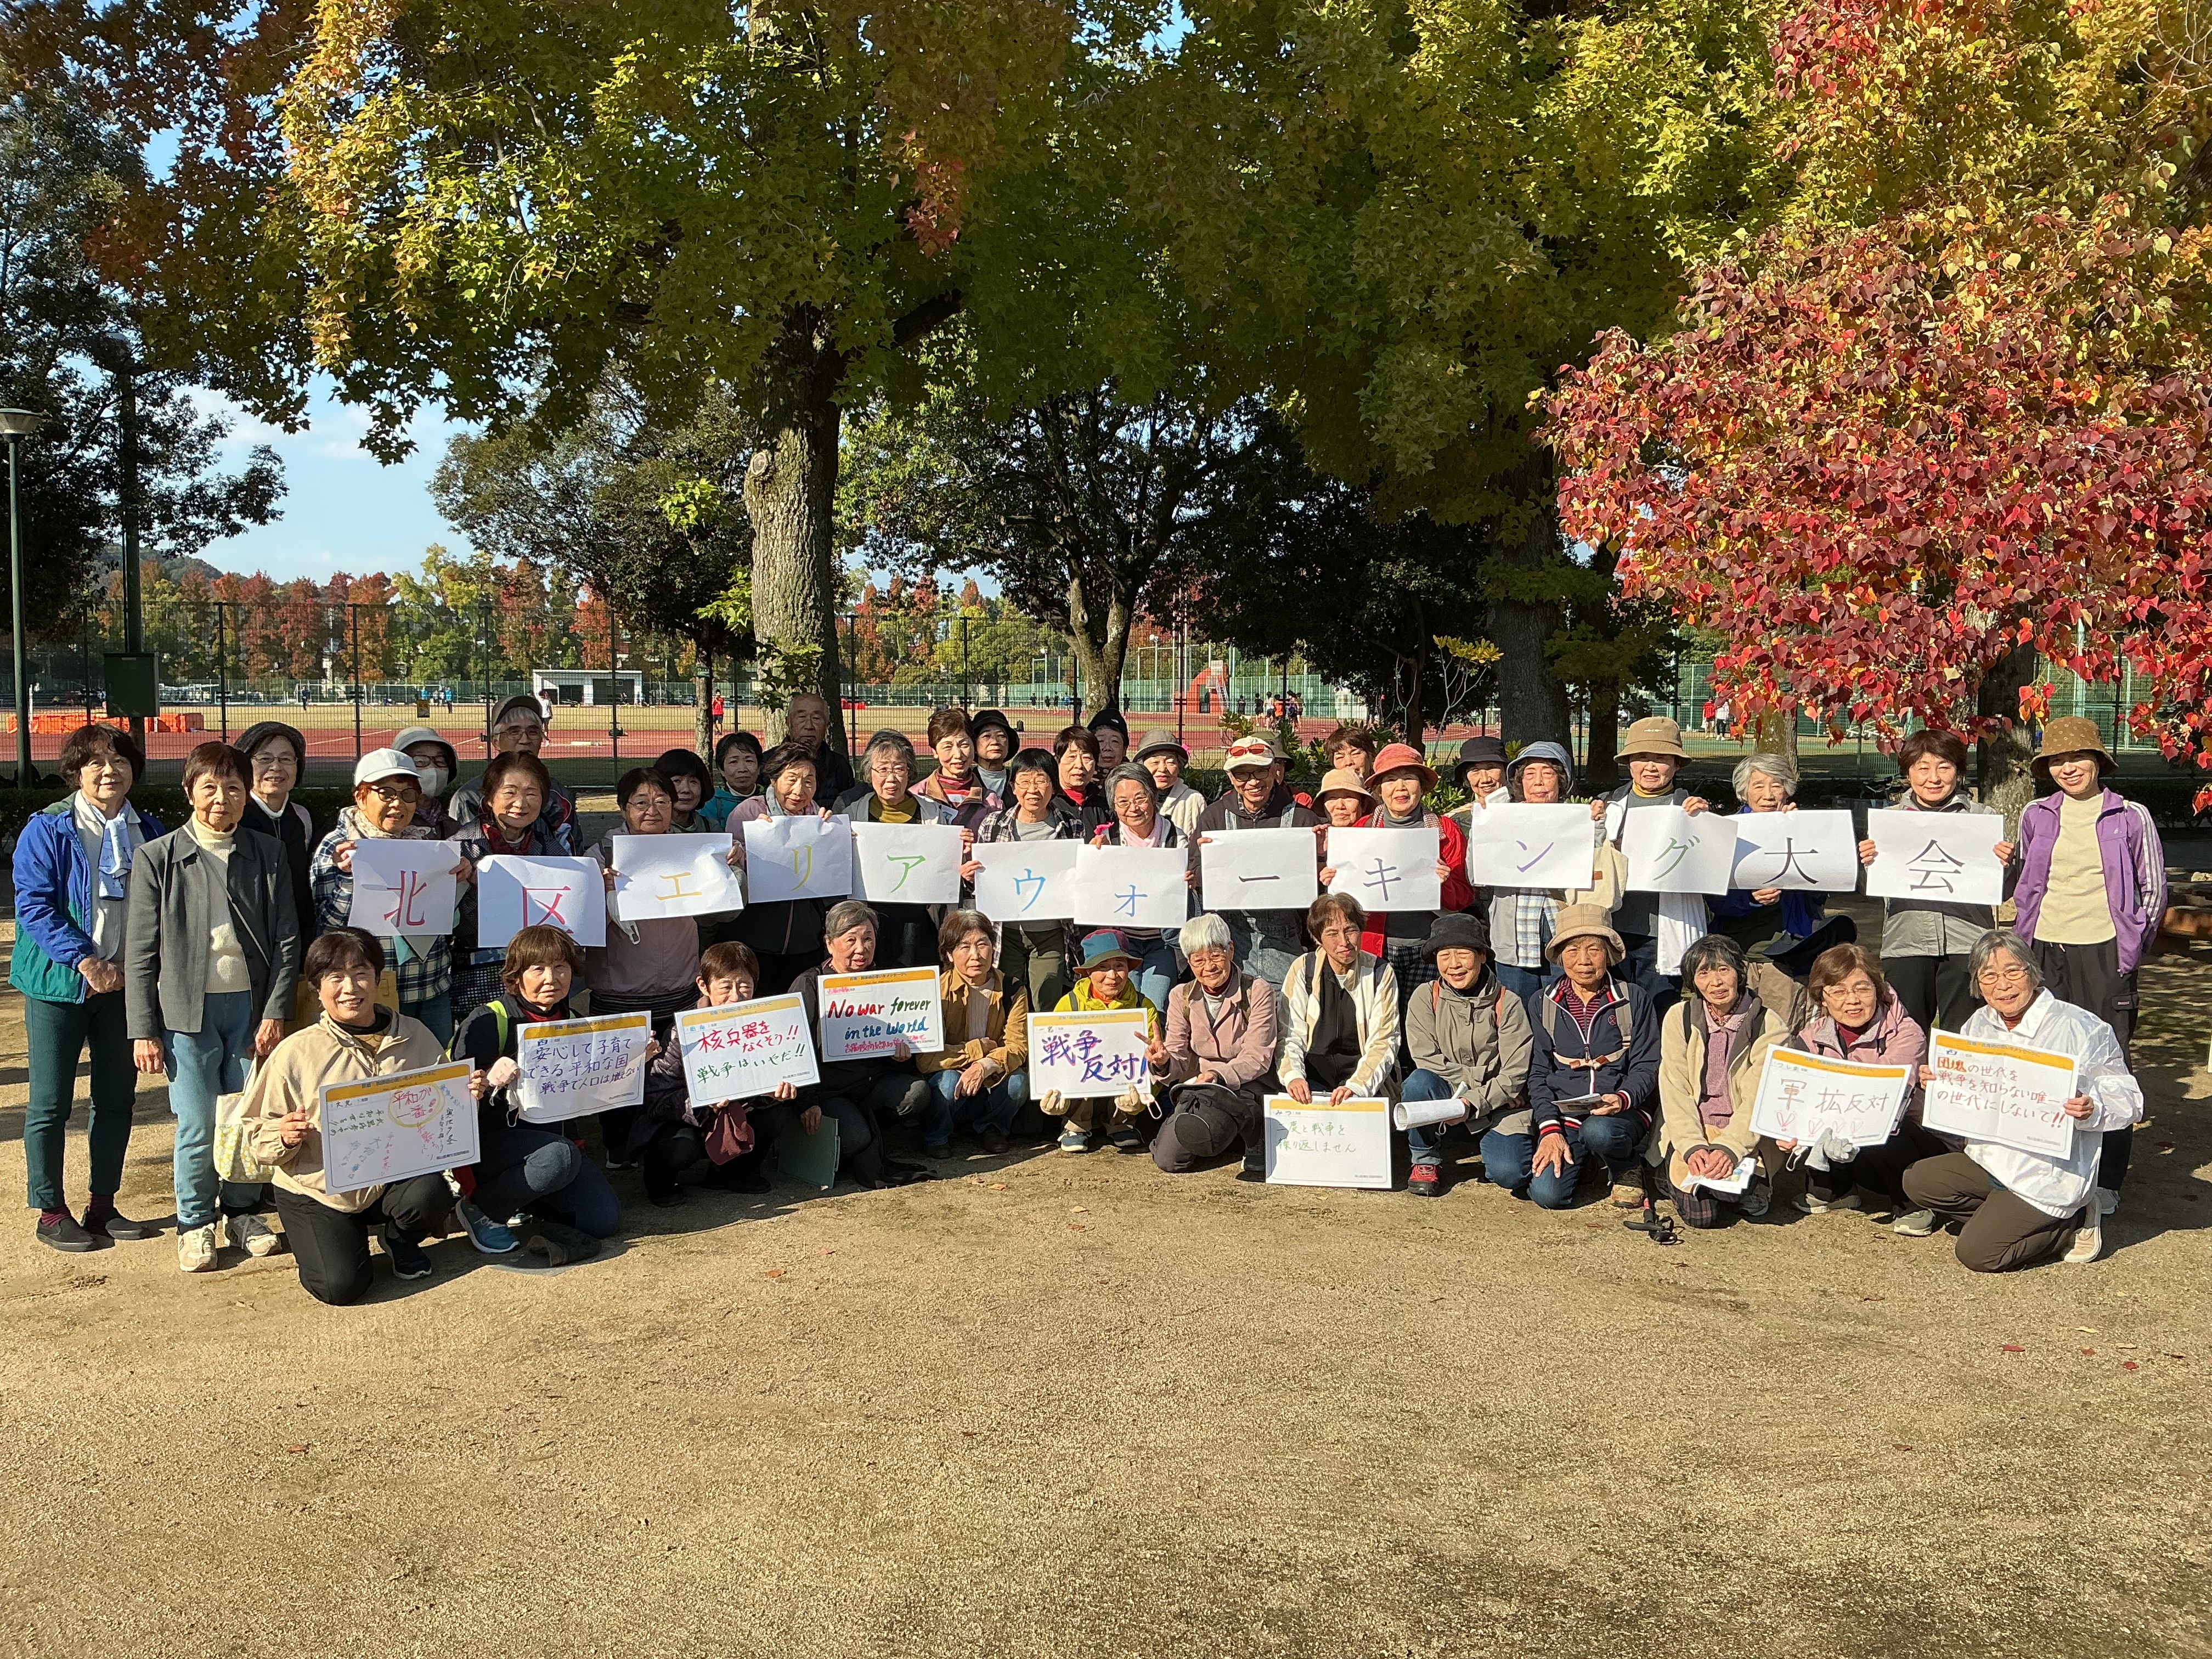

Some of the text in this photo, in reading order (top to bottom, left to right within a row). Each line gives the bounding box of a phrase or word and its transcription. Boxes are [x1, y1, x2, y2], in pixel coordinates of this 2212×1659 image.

[384, 870, 427, 928] 北
[522, 885, 574, 934] 区
[655, 872, 702, 901] エ
[790, 845, 811, 891] リ
[886, 855, 926, 893] ア
[1013, 868, 1046, 912] ウ
[1363, 857, 1401, 901] キ
[1516, 840, 1554, 872] ン
[1654, 835, 1701, 881] グ
[1763, 837, 1819, 885] 大
[1905, 839, 1965, 894] 会
[828, 997, 931, 1018] No war forever
[698, 1020, 770, 1053] 核兵器を
[844, 1027, 860, 1040] in
[862, 1025, 882, 1037] the
[1041, 1030, 1102, 1066] 戦争
[1937, 1057, 2018, 1082] 団塊の世代を
[393, 1087, 432, 1109] 平和が
[1938, 1070, 2060, 1103] 戦争を知らない唯一
